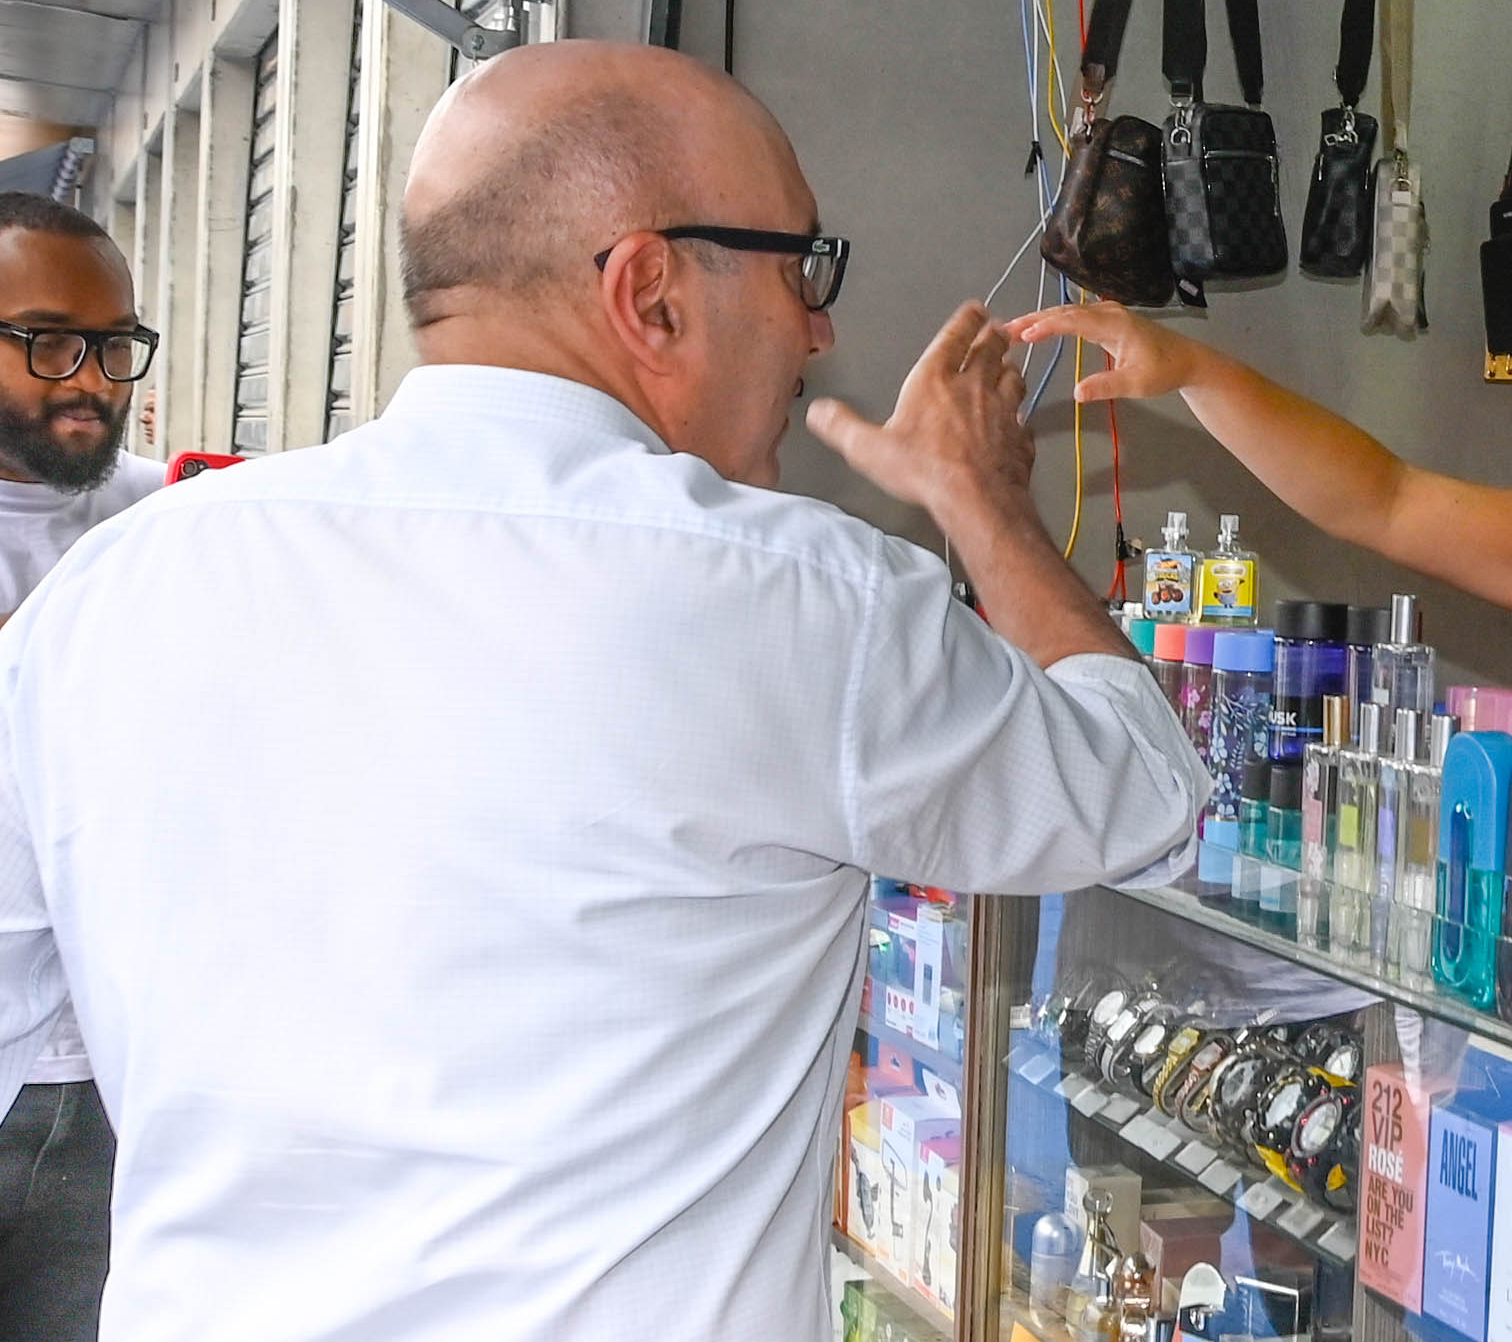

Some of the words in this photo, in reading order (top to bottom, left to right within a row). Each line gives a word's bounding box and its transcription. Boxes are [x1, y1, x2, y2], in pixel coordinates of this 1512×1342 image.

[1269, 711, 1297, 726] USK
[1372, 1079, 1402, 1122] 212
[1372, 1111, 1403, 1152] VIP
[1368, 1144, 1404, 1185] ROSÉ
[1439, 1128, 1478, 1202] ANGEL
[1367, 1195, 1381, 1216] ON
[1385, 1202, 1405, 1231] THE
[1368, 1175, 1388, 1200] ARE
[1392, 1186, 1414, 1213] YOU
[1366, 1215, 1395, 1245] LIST?
[1365, 1238, 1389, 1267] NYC
